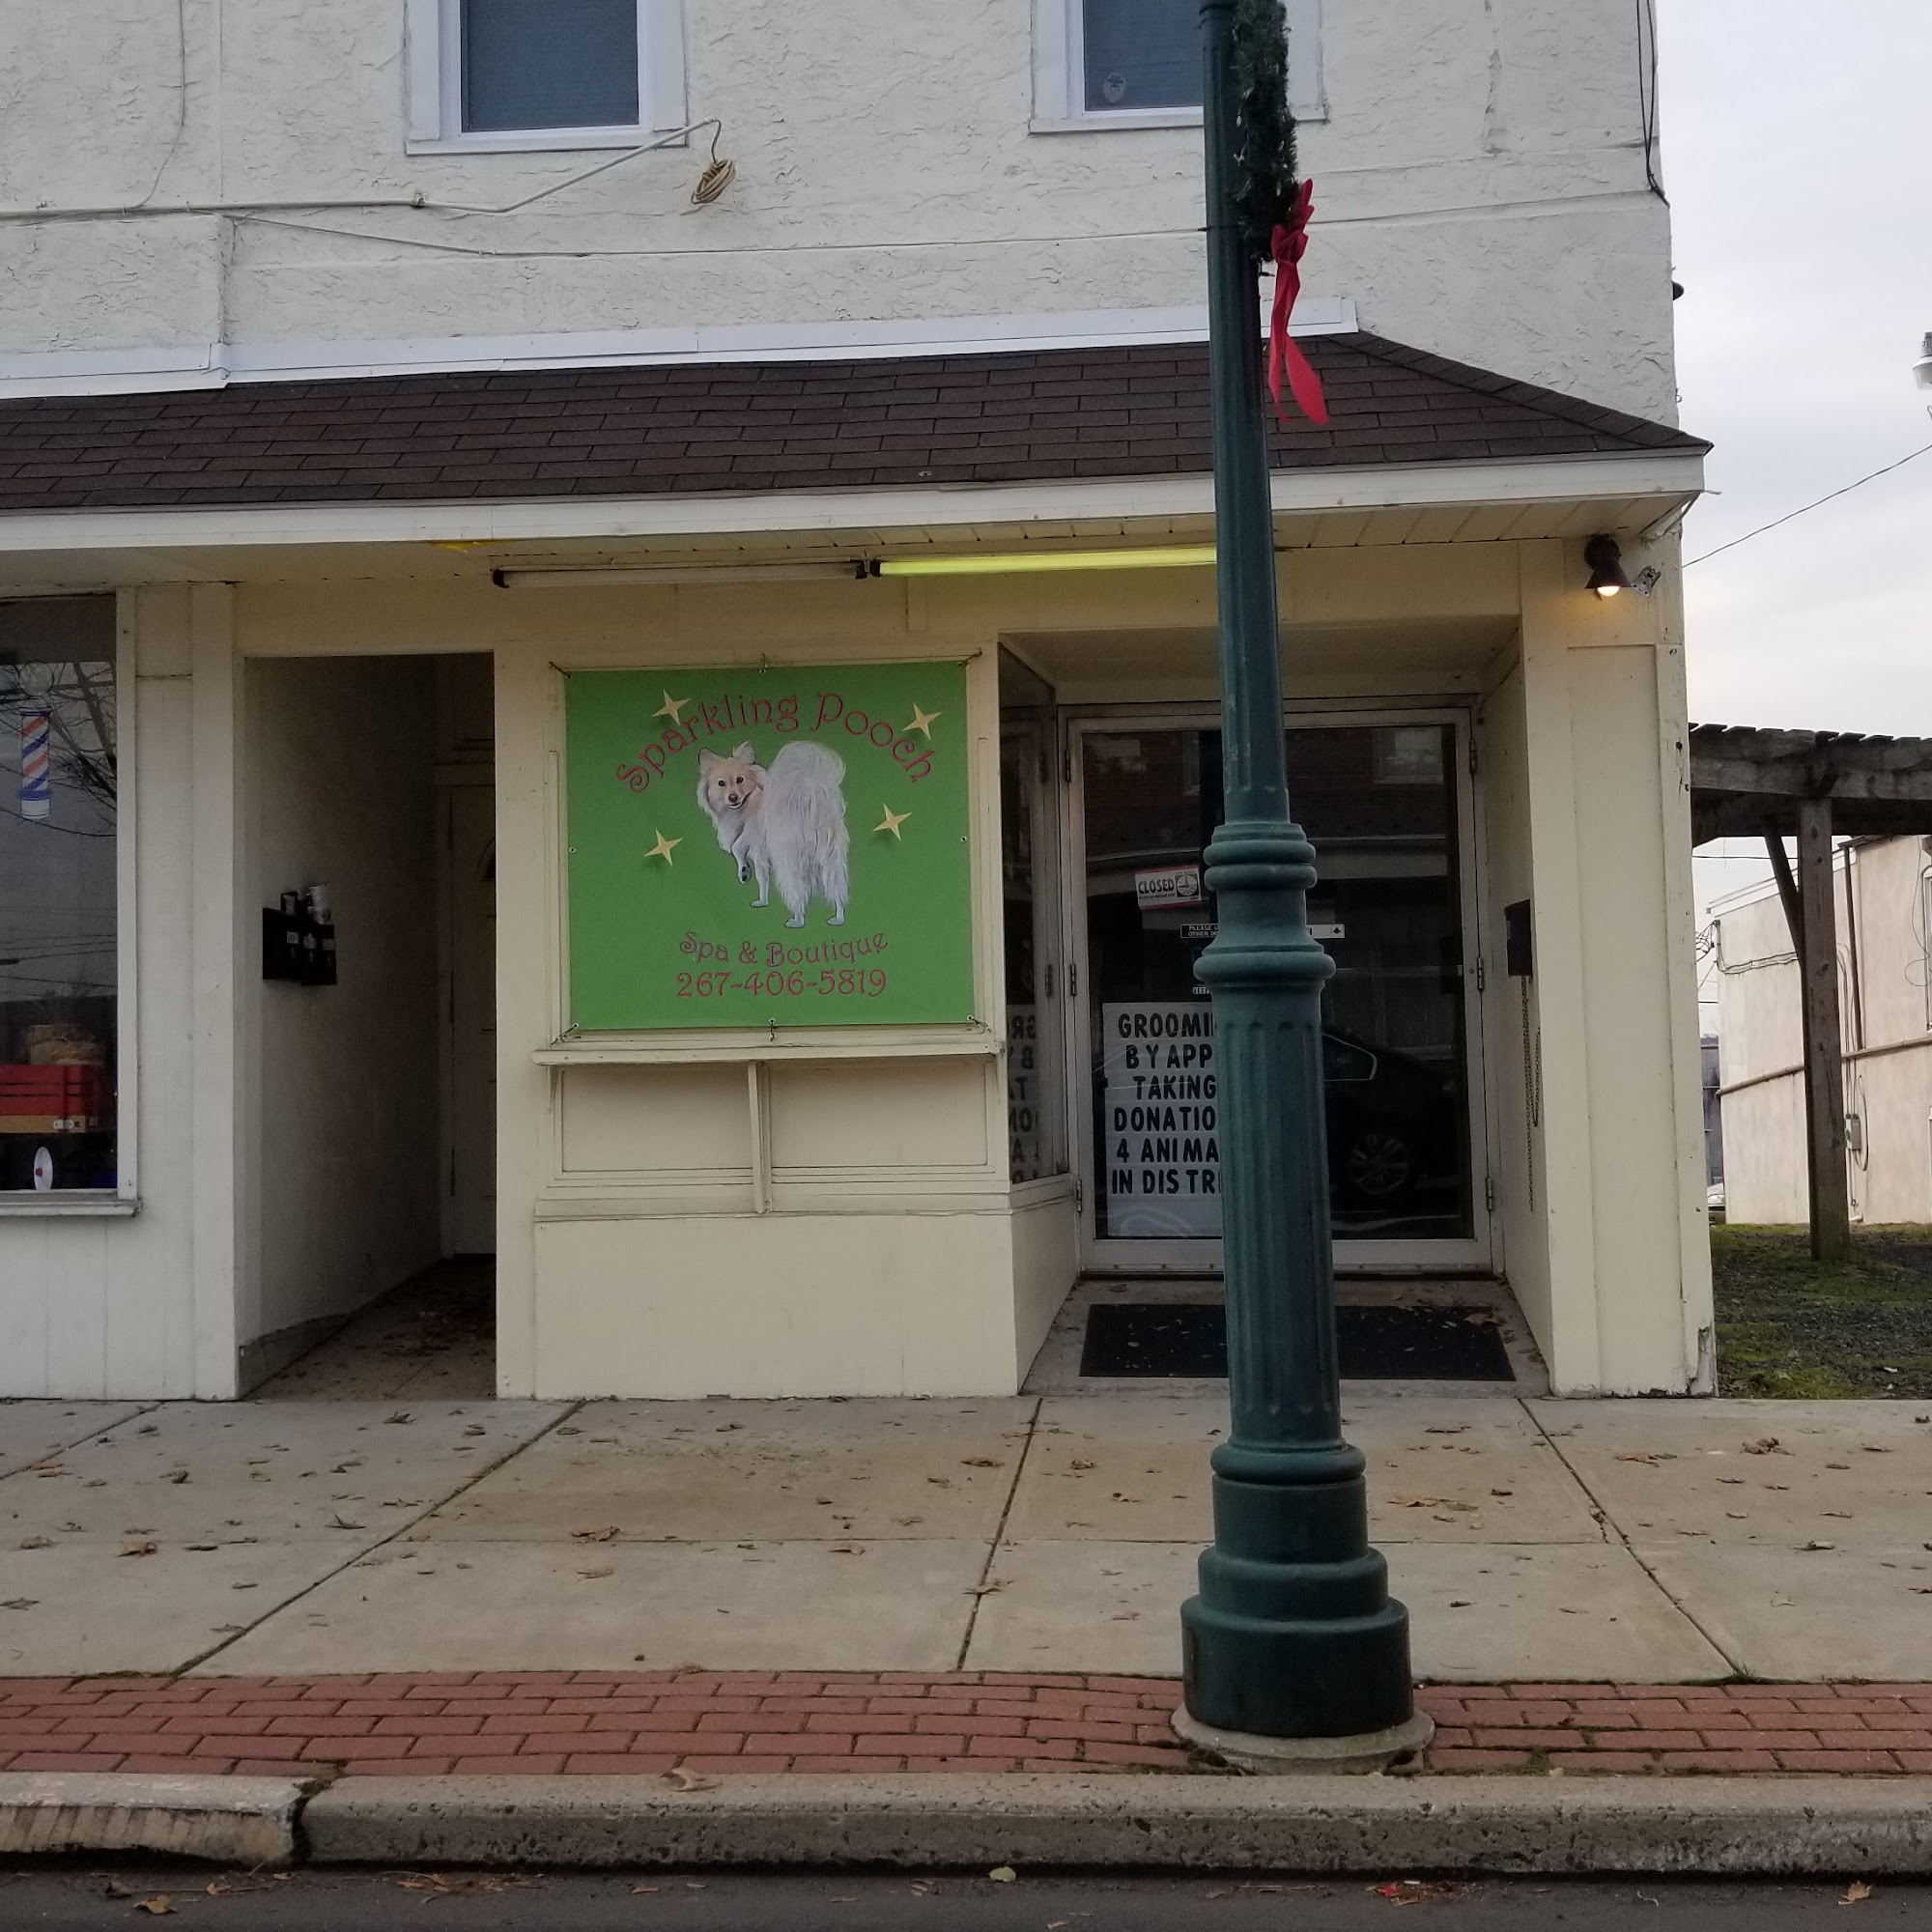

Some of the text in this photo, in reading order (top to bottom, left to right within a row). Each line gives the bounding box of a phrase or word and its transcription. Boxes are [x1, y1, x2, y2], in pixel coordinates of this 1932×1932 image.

[616, 692, 935, 793] Sparkling Pooch
[1138, 878, 1175, 895] CLOSED
[680, 931, 888, 967] Spa & Boutique
[676, 969, 887, 998] 267-406-5819
[1118, 1012, 1214, 1037] GROOMI
[1125, 1043, 1213, 1068] BY APP
[1133, 1074, 1216, 1099] TAKING
[1114, 1106, 1216, 1131] DONATIO
[1117, 1137, 1219, 1163] 4 ANIMA
[1112, 1169, 1133, 1194] IN
